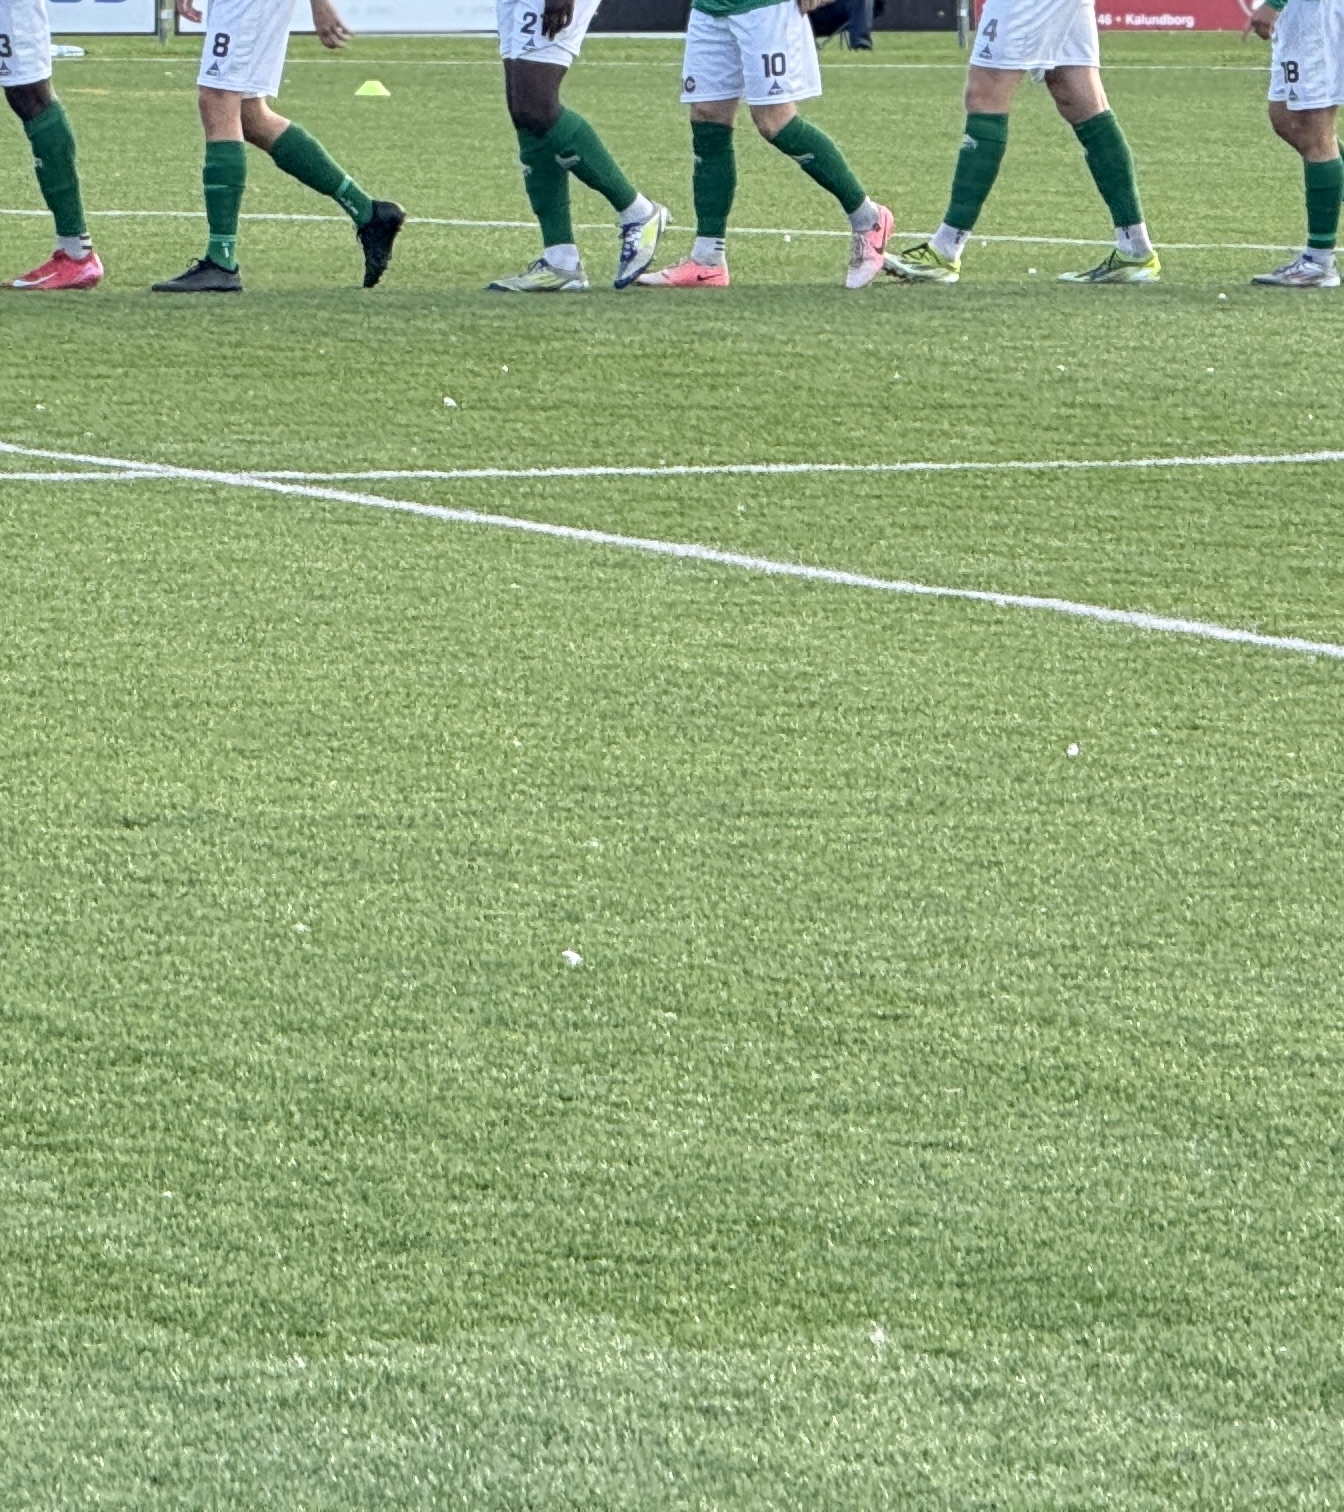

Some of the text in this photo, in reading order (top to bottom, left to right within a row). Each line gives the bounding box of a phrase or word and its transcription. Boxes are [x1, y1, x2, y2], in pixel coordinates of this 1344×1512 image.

[982, 18, 999, 43] 4
[1125, 13, 1195, 28] Kalundborg
[212, 32, 230, 57] 8
[761, 52, 786, 78] 10
[1280, 61, 1299, 84] 18
